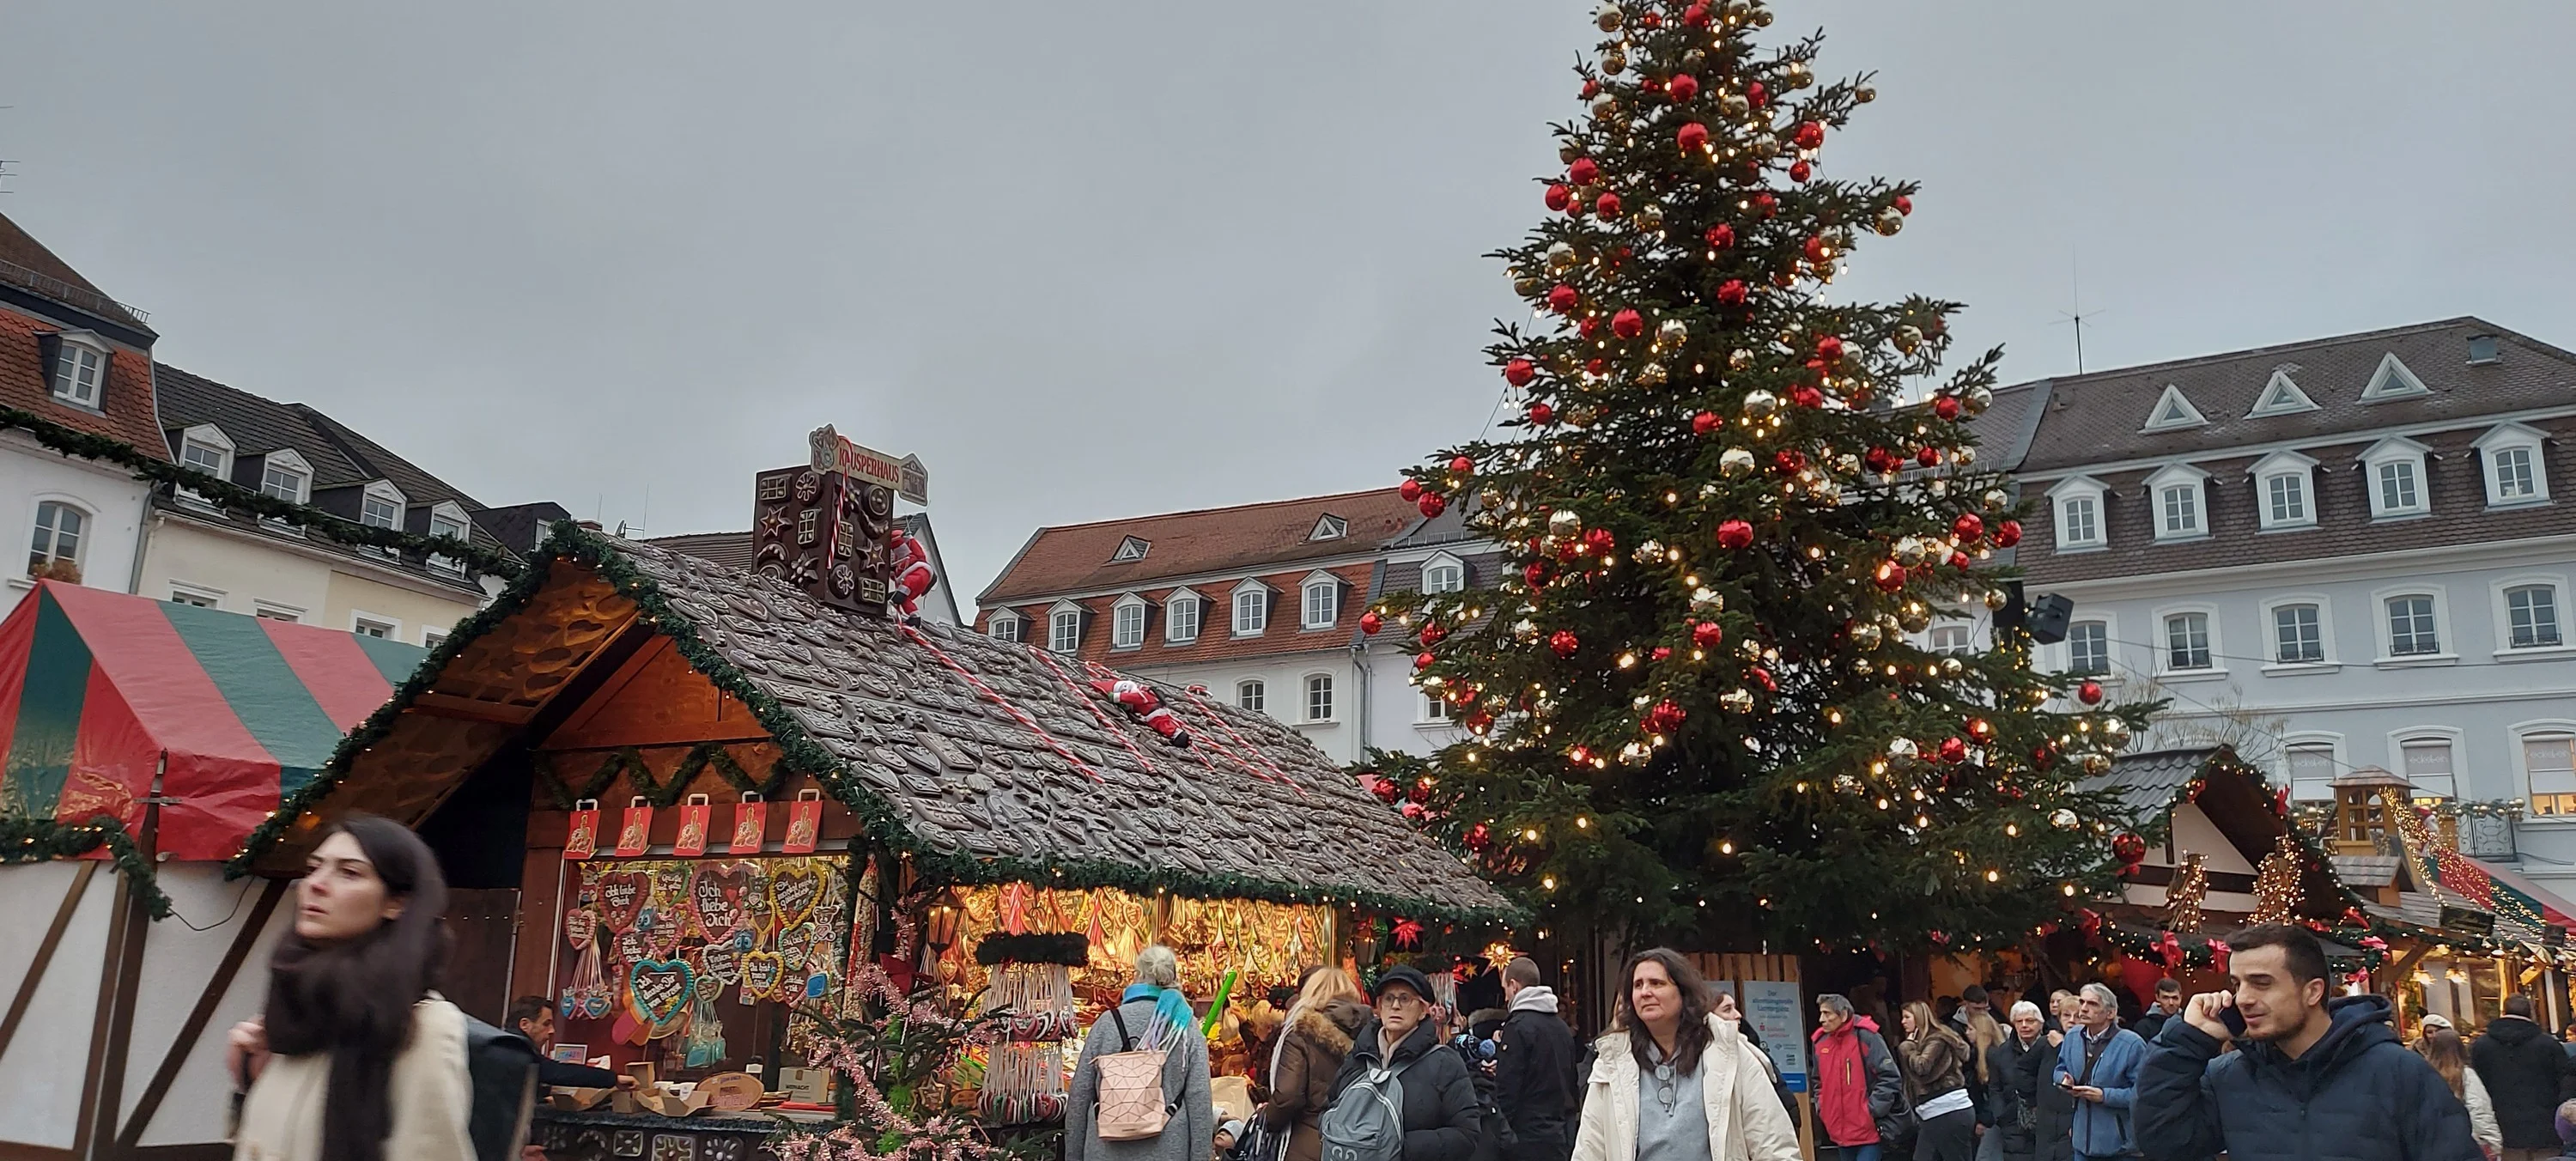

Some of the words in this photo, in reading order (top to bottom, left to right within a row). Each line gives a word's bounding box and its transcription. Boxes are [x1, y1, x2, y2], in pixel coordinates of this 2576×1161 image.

[699, 880, 721, 897] Ich
[701, 898, 728, 912] liebe
[705, 913, 732, 927] Dich
[636, 975, 653, 989] Ich
